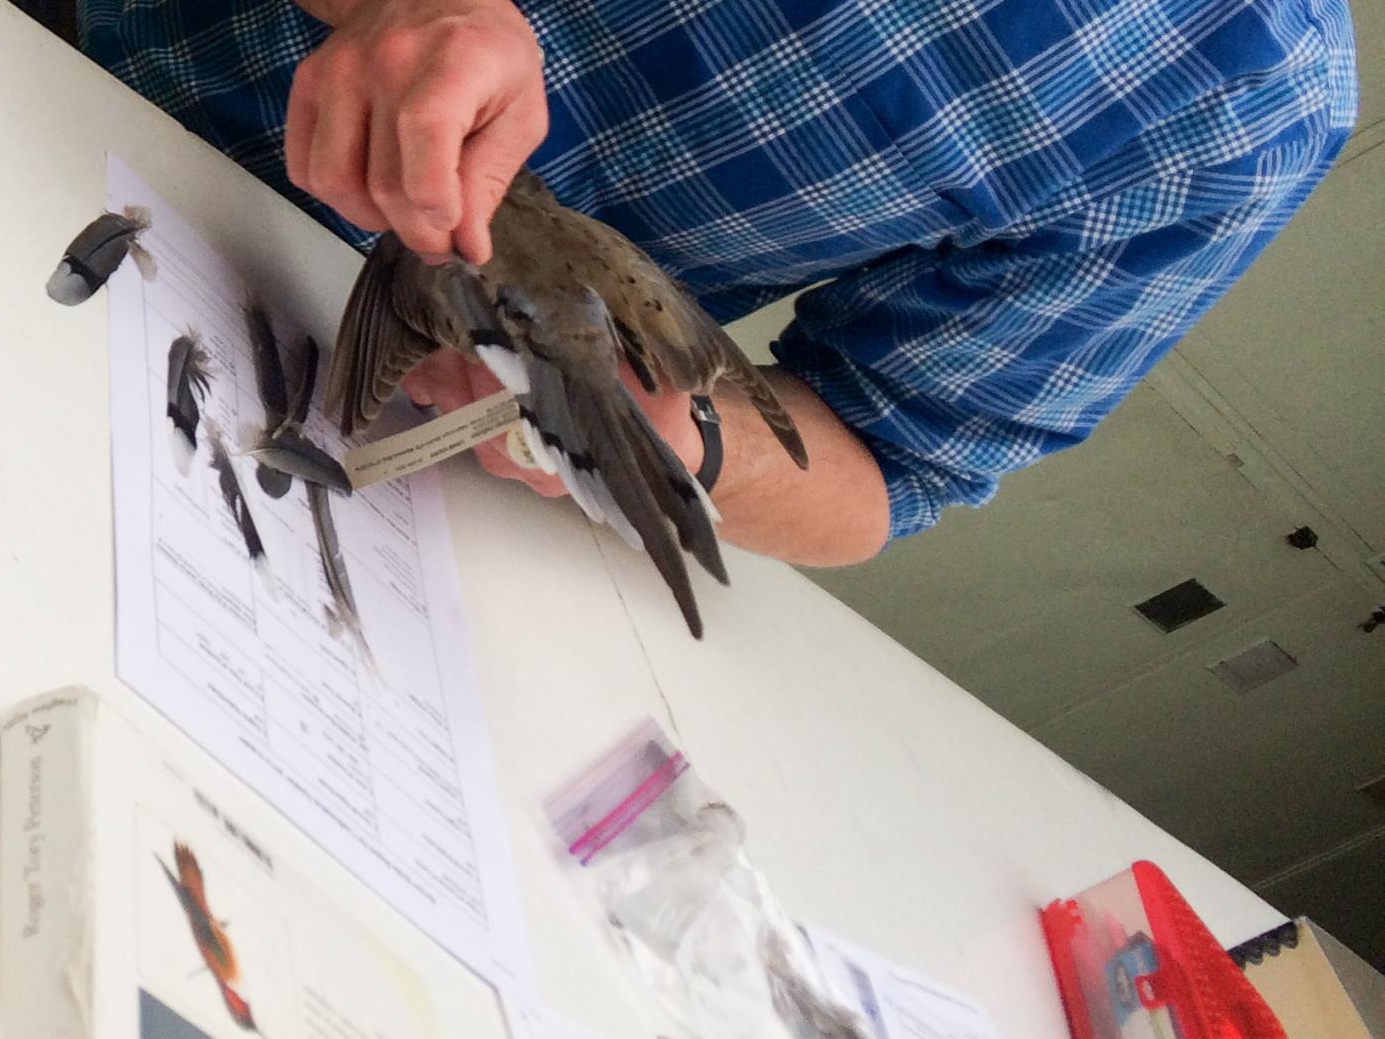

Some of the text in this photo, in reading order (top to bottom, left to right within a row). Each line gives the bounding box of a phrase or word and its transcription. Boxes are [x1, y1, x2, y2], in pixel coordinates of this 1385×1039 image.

[22, 754, 46, 940] Roger Tory Peterson
